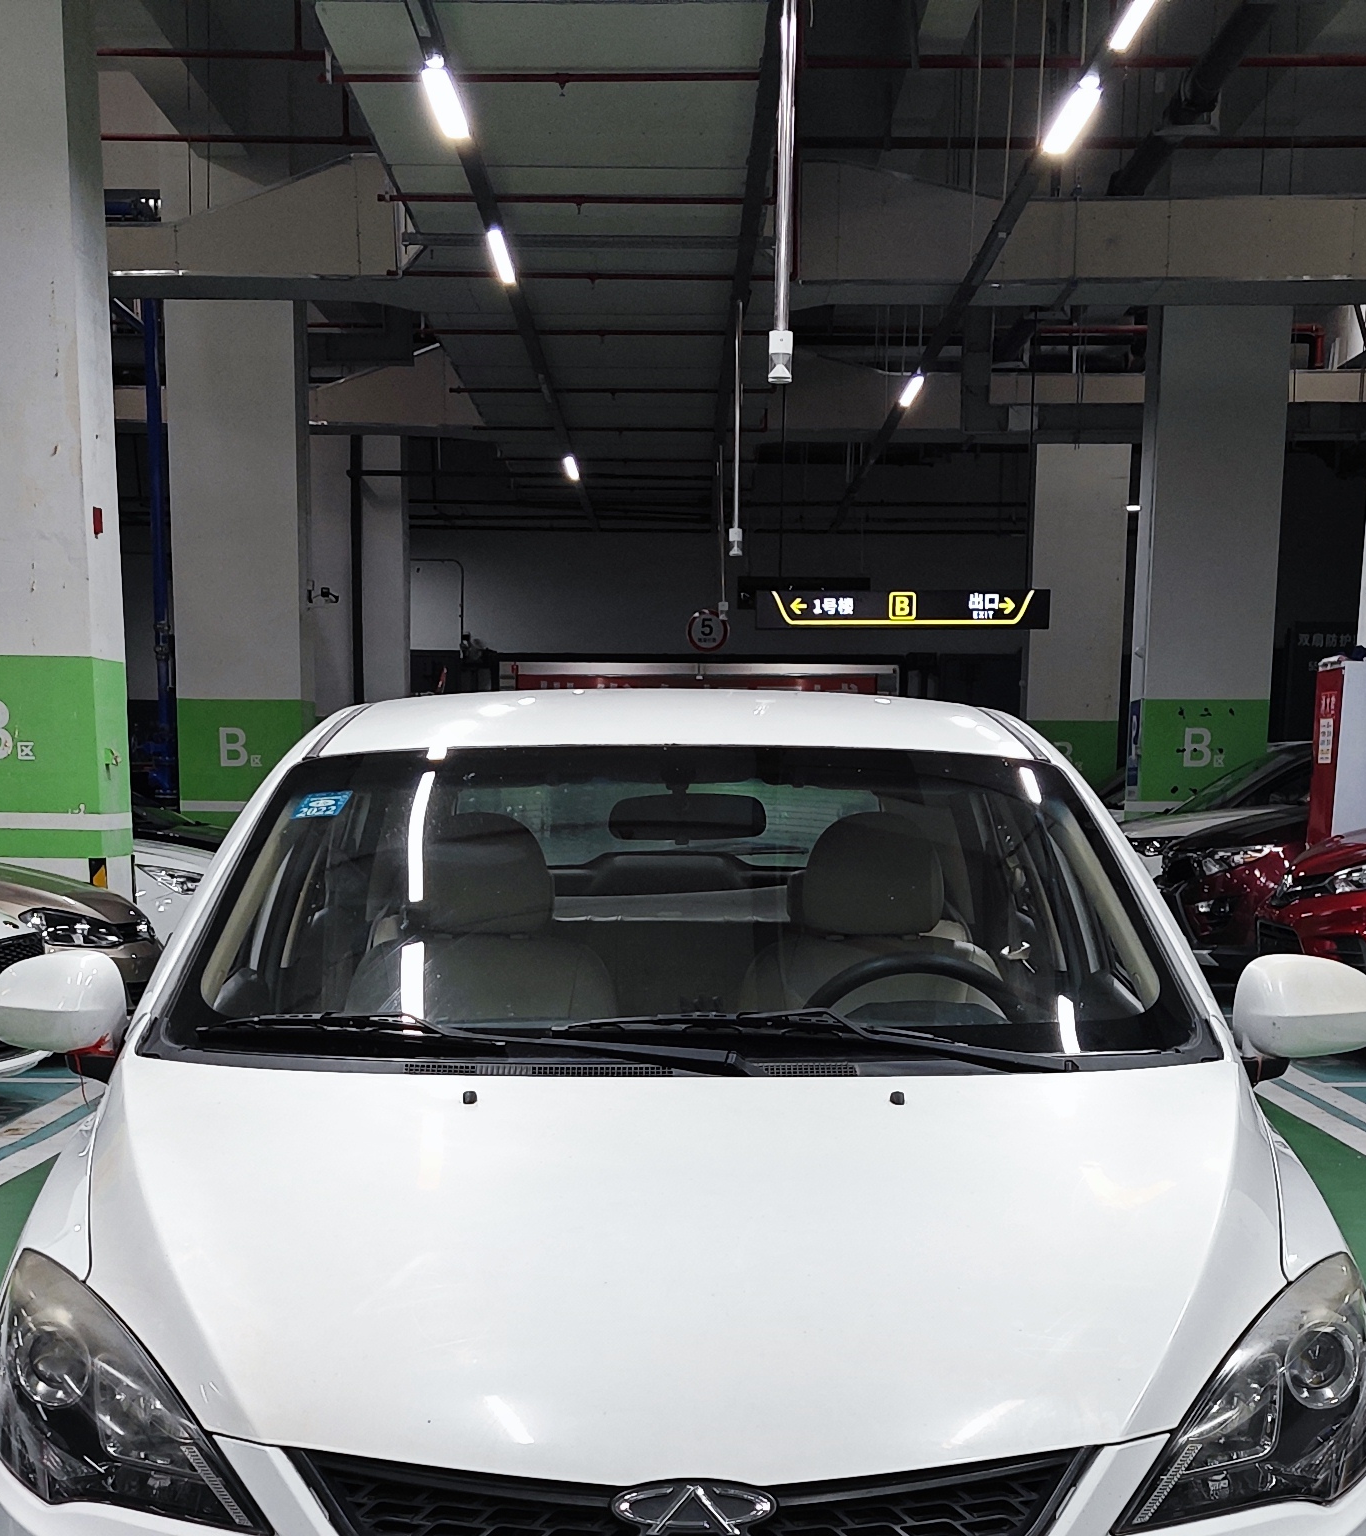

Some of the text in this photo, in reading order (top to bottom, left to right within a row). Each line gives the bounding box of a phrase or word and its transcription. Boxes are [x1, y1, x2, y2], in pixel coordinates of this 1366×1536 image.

[895, 596, 910, 616] B
[968, 592, 999, 610] 出口
[972, 610, 994, 619] EXIT
[701, 618, 713, 637] 5
[1298, 633, 1356, 648] 双扇防护
[295, 805, 337, 817] 2022
